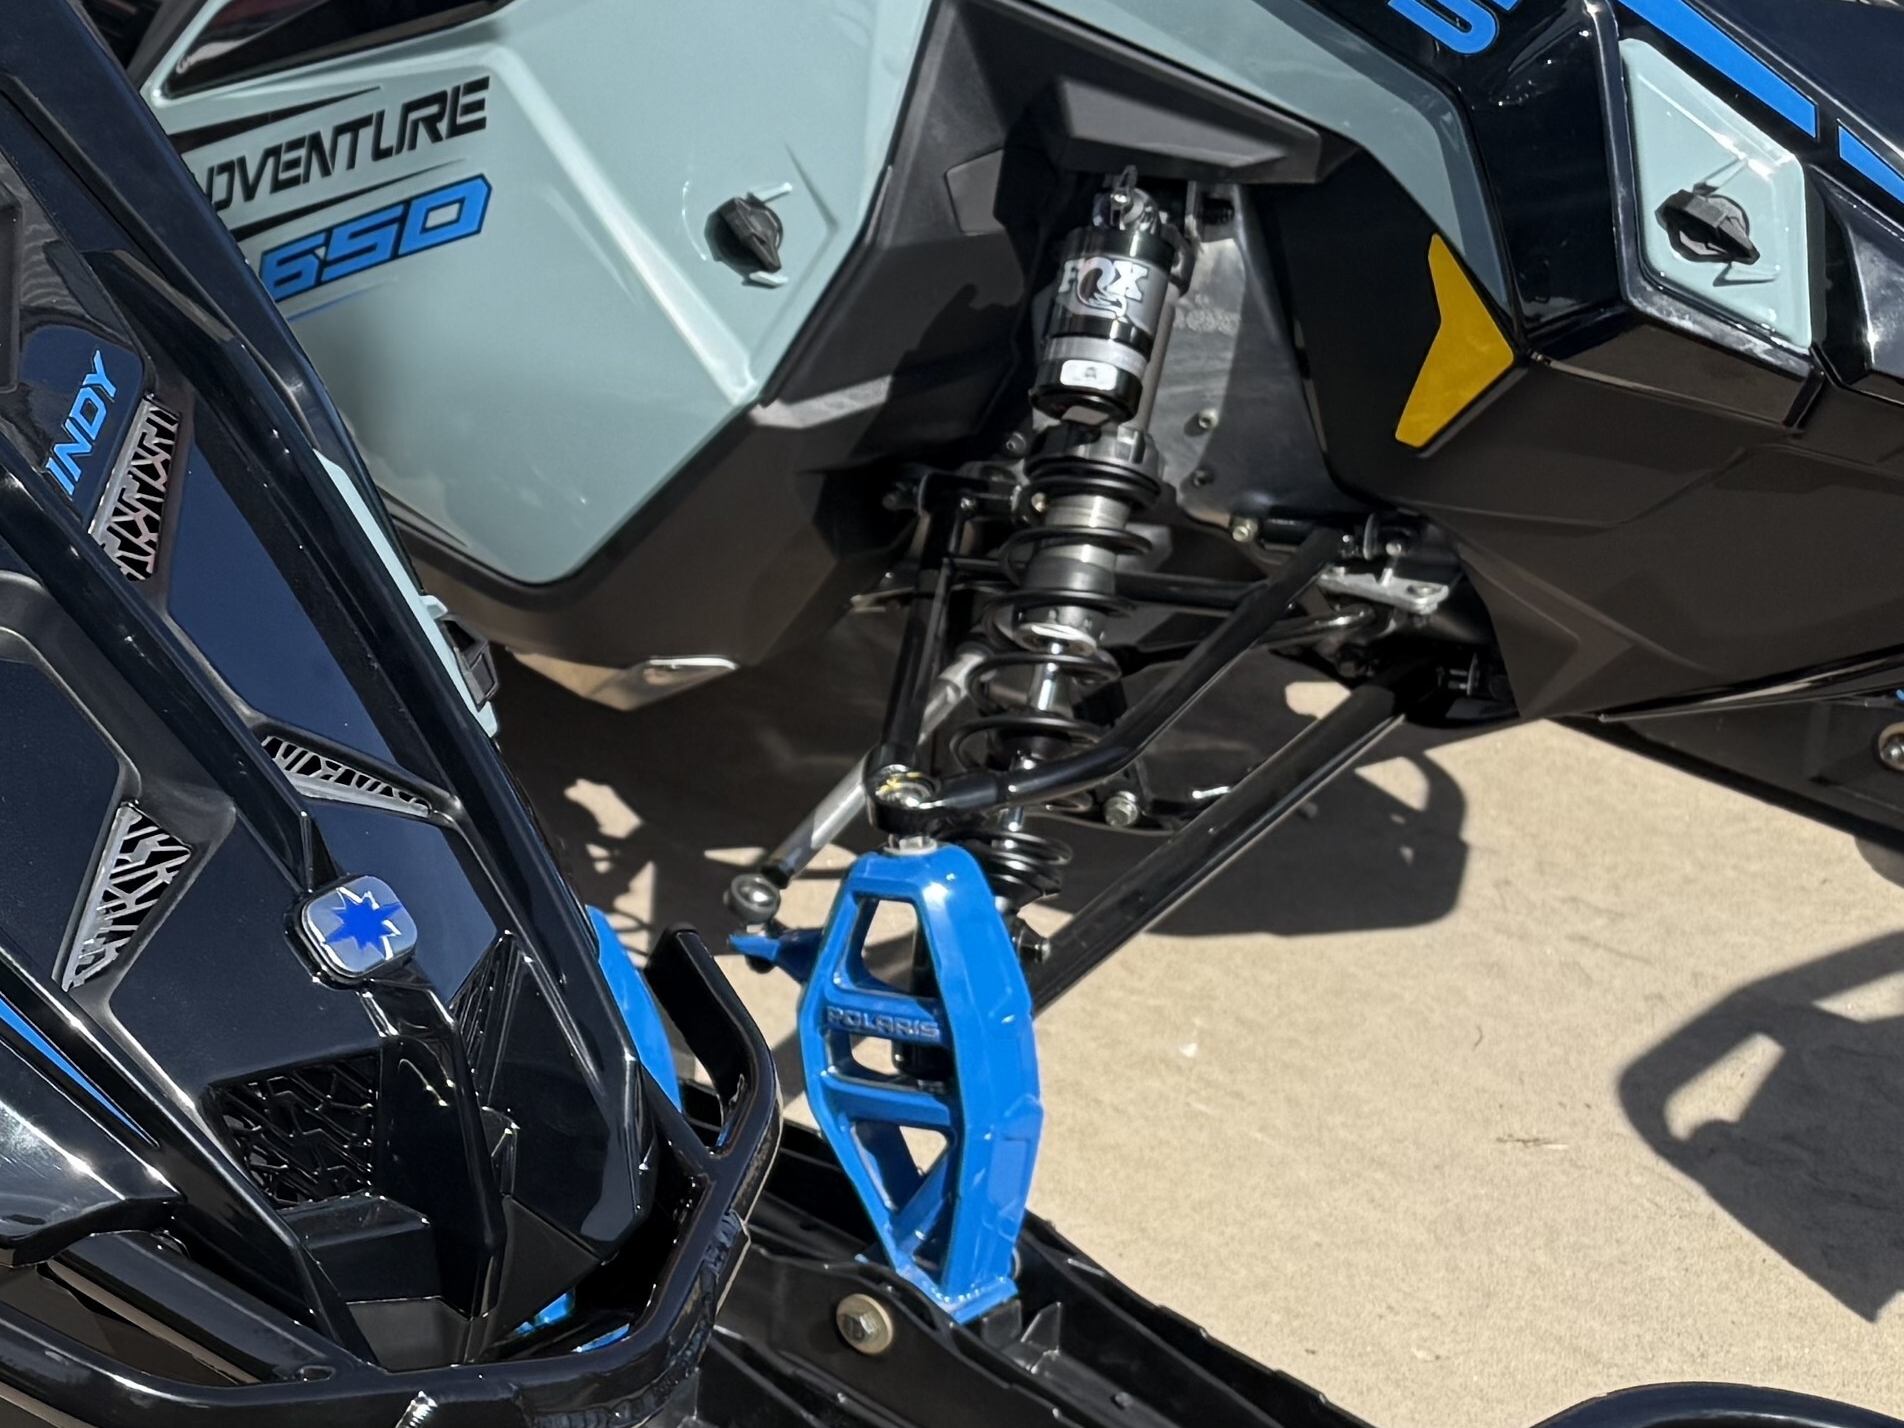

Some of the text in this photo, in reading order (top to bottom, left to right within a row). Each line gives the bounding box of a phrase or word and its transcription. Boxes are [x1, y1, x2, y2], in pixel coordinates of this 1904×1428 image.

[202, 74, 490, 213] DVENTURE
[258, 172, 493, 304] 650
[1058, 255, 1149, 320] FOX
[46, 351, 121, 497] INDY
[826, 1004, 941, 1039] POLARIS
